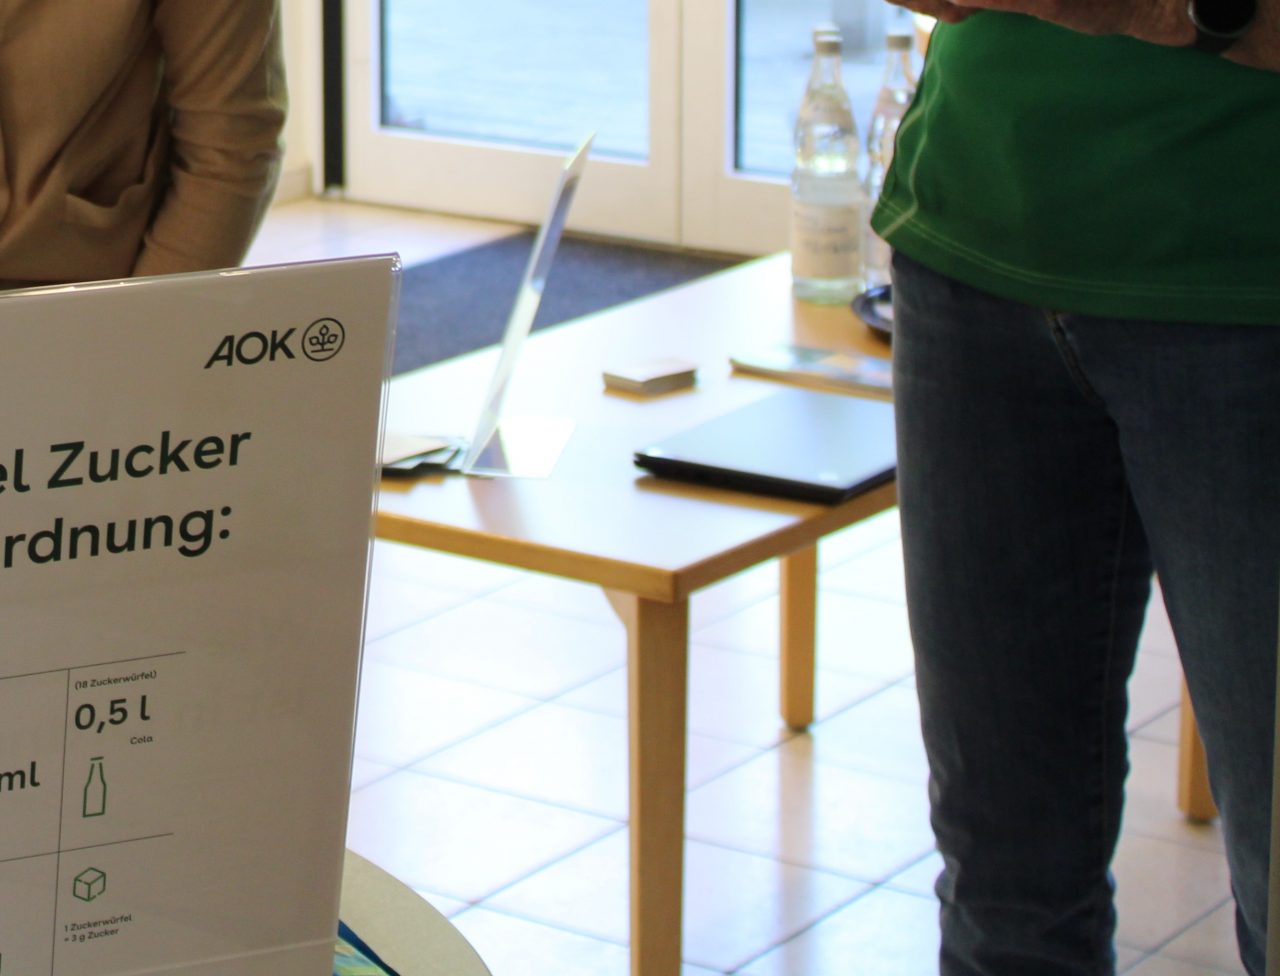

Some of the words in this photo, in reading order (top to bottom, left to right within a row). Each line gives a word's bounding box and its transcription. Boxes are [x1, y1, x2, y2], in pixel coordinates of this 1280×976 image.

[204, 327, 296, 370] AOK
[47, 430, 252, 490] Zucker
[90, 670, 157, 687] Zuckerwürfel)
[74, 698, 128, 734] 0,5
[140, 695, 151, 721] l
[130, 735, 154, 745] Cola
[70, 913, 132, 931] Zuckerwürfel
[71, 934, 77, 942] 3
[87, 928, 120, 939] Zucker
